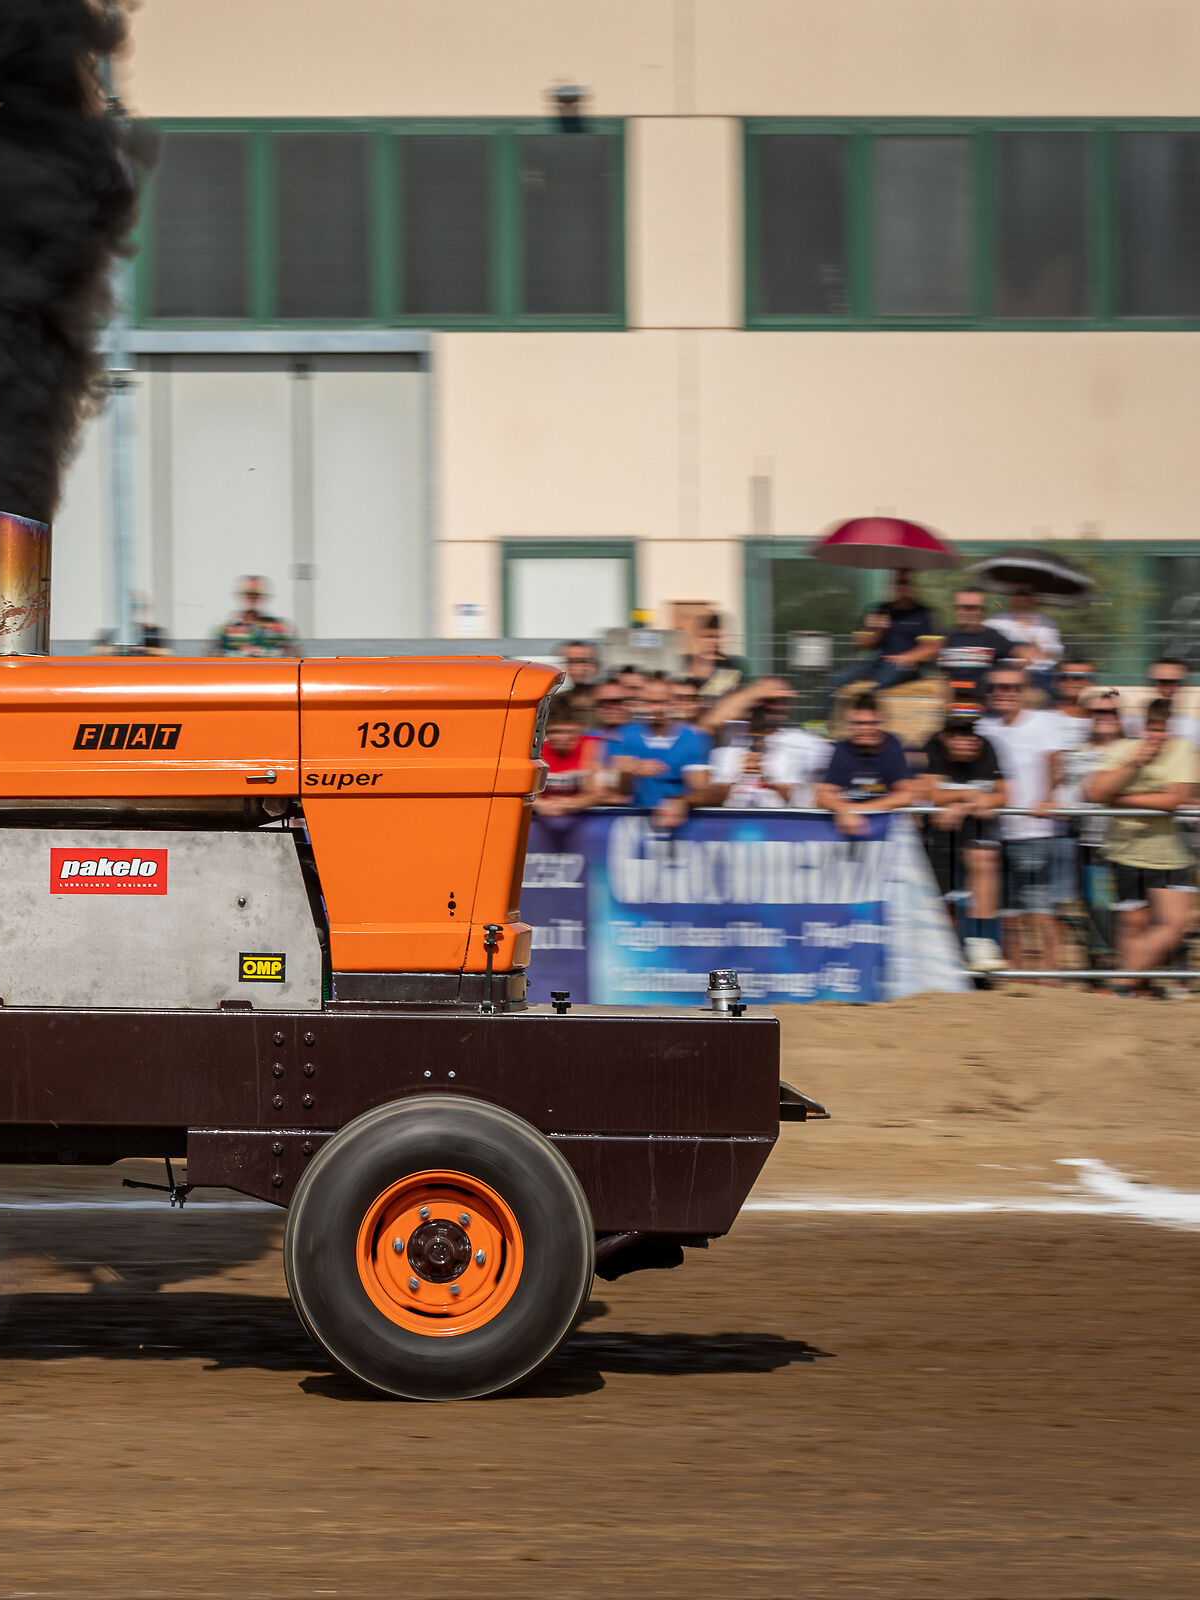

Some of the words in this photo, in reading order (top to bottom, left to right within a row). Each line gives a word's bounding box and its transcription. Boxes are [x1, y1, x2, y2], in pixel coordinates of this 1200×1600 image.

[75, 725, 180, 748] FIAT
[357, 722, 440, 748] 1300
[304, 773, 383, 790] super
[59, 857, 158, 879] pakelo
[242, 960, 282, 975] OMP
